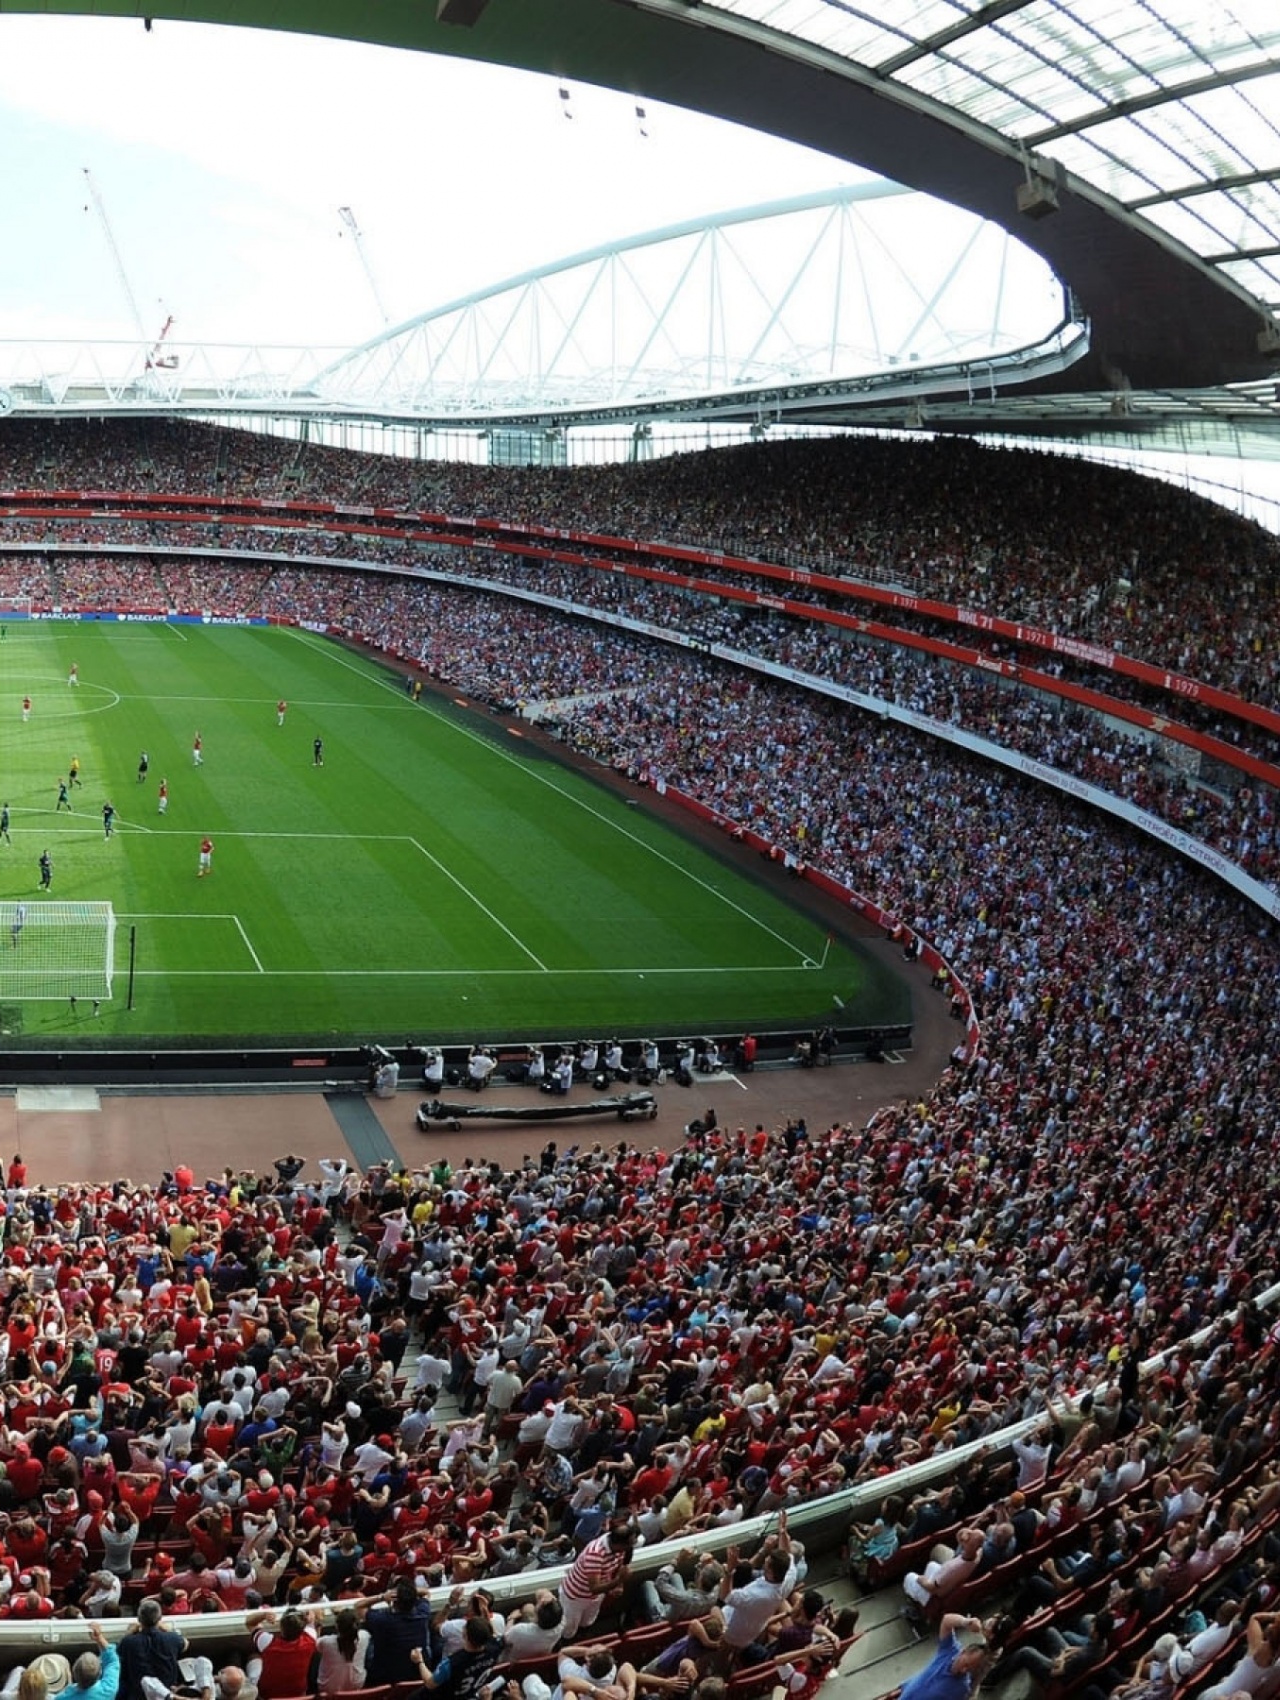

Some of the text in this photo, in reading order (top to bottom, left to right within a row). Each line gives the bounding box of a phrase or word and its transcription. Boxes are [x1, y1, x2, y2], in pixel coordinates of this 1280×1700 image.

[41, 612, 82, 620] BARCLAYS
[127, 613, 167, 621] BARCLAYS
[212, 615, 250, 625] BARCLAYS
[979, 614, 993, 629] 71
[1026, 630, 1046, 645] 1971
[1175, 679, 1199, 697] 1979
[100, 1357, 113, 1372] 19
